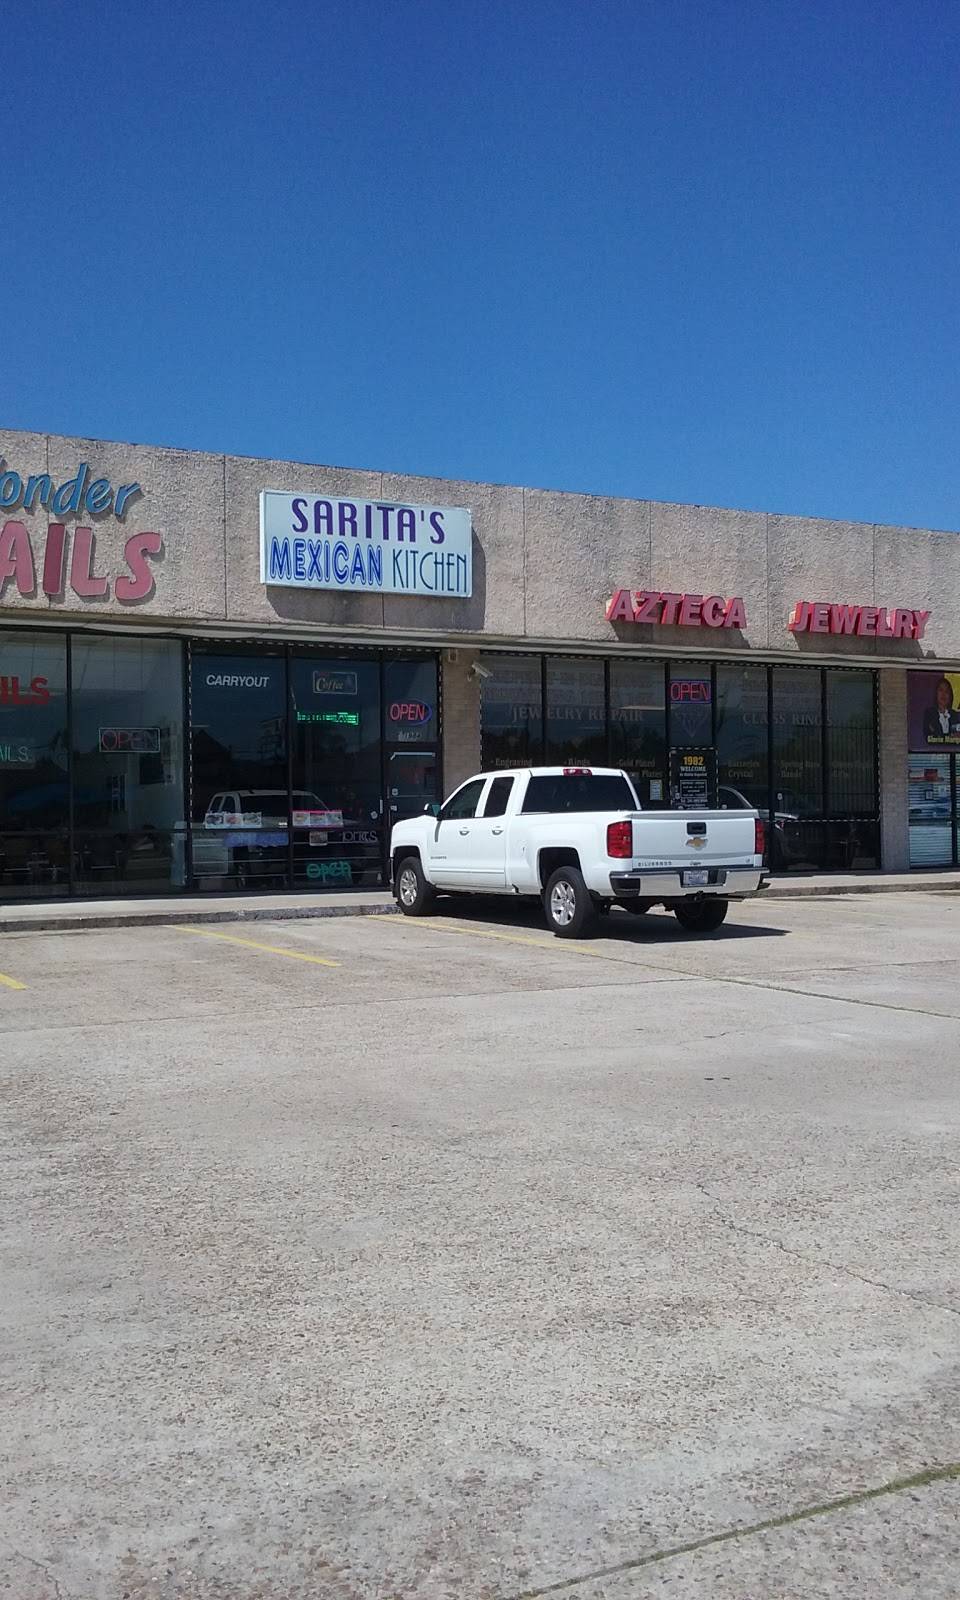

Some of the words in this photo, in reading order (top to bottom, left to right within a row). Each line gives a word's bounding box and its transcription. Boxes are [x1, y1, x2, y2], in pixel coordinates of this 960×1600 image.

[0, 463, 141, 517] onder
[291, 498, 445, 544] SARITA'S
[269, 536, 383, 587] MEXICAN
[393, 548, 467, 593] KITCHEN
[606, 589, 747, 629] AZTECA
[788, 601, 932, 640] JEWELRY
[206, 675, 270, 688] CARRYOUT
[670, 682, 711, 701] OPEN
[390, 703, 425, 720] OPEN
[512, 707, 583, 722] JEWELRY
[588, 708, 643, 722] REPAIR
[102, 730, 158, 750] OPEN
